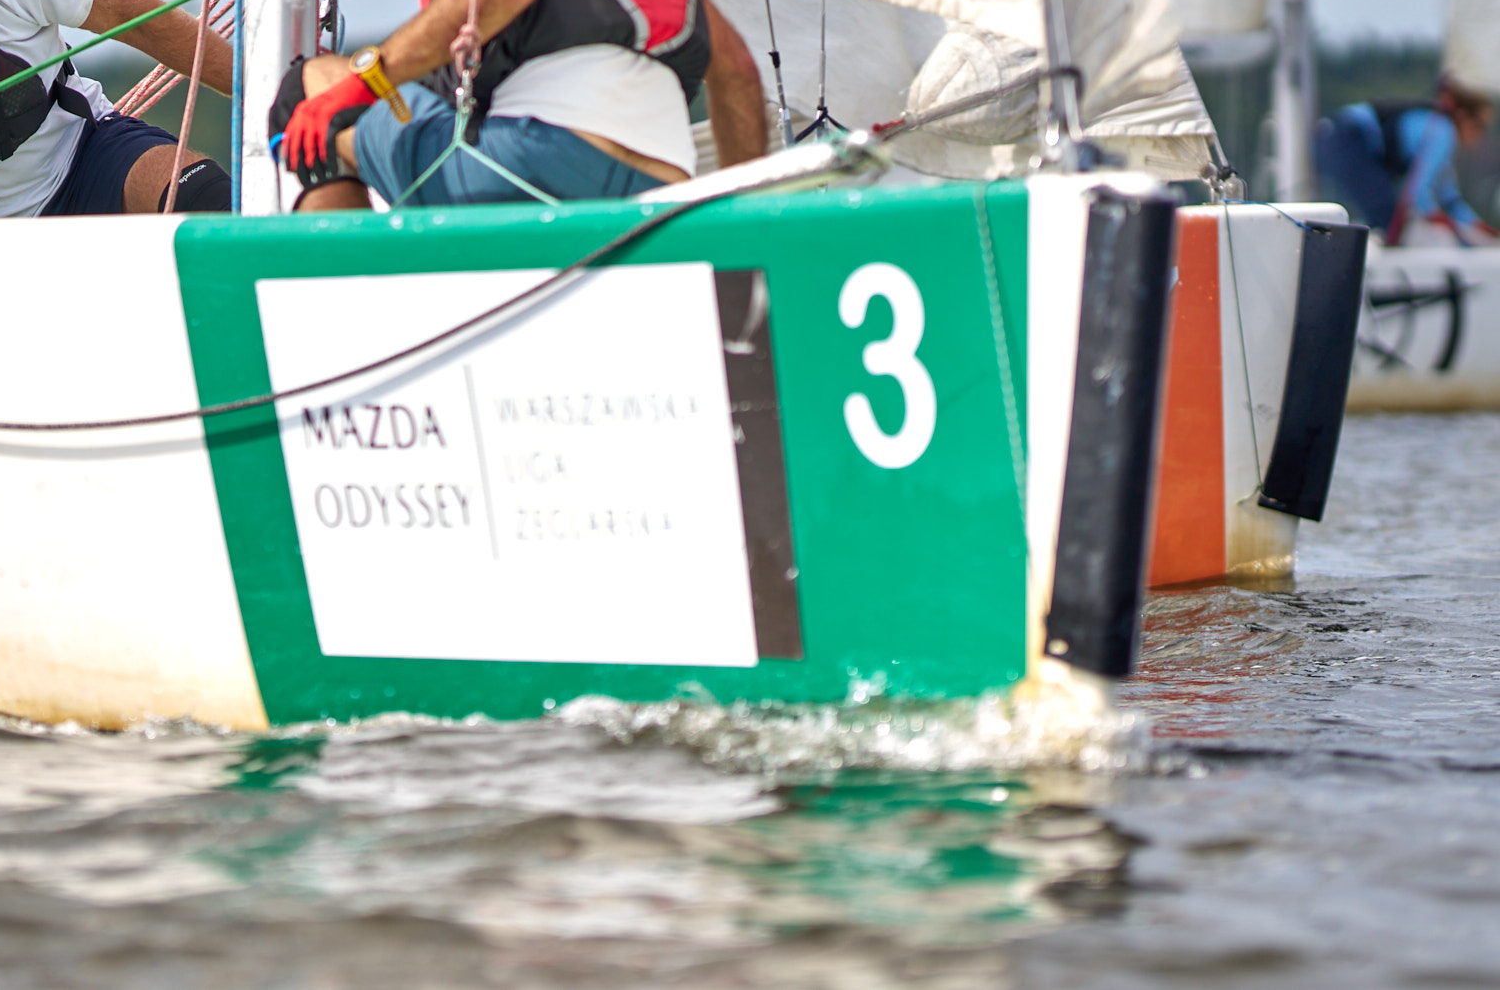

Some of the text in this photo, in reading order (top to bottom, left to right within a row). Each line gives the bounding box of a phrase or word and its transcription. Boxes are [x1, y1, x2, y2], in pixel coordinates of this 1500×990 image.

[838, 262, 937, 469] 3
[302, 404, 447, 450] MAZDA
[314, 482, 473, 529] ODYSSEY
